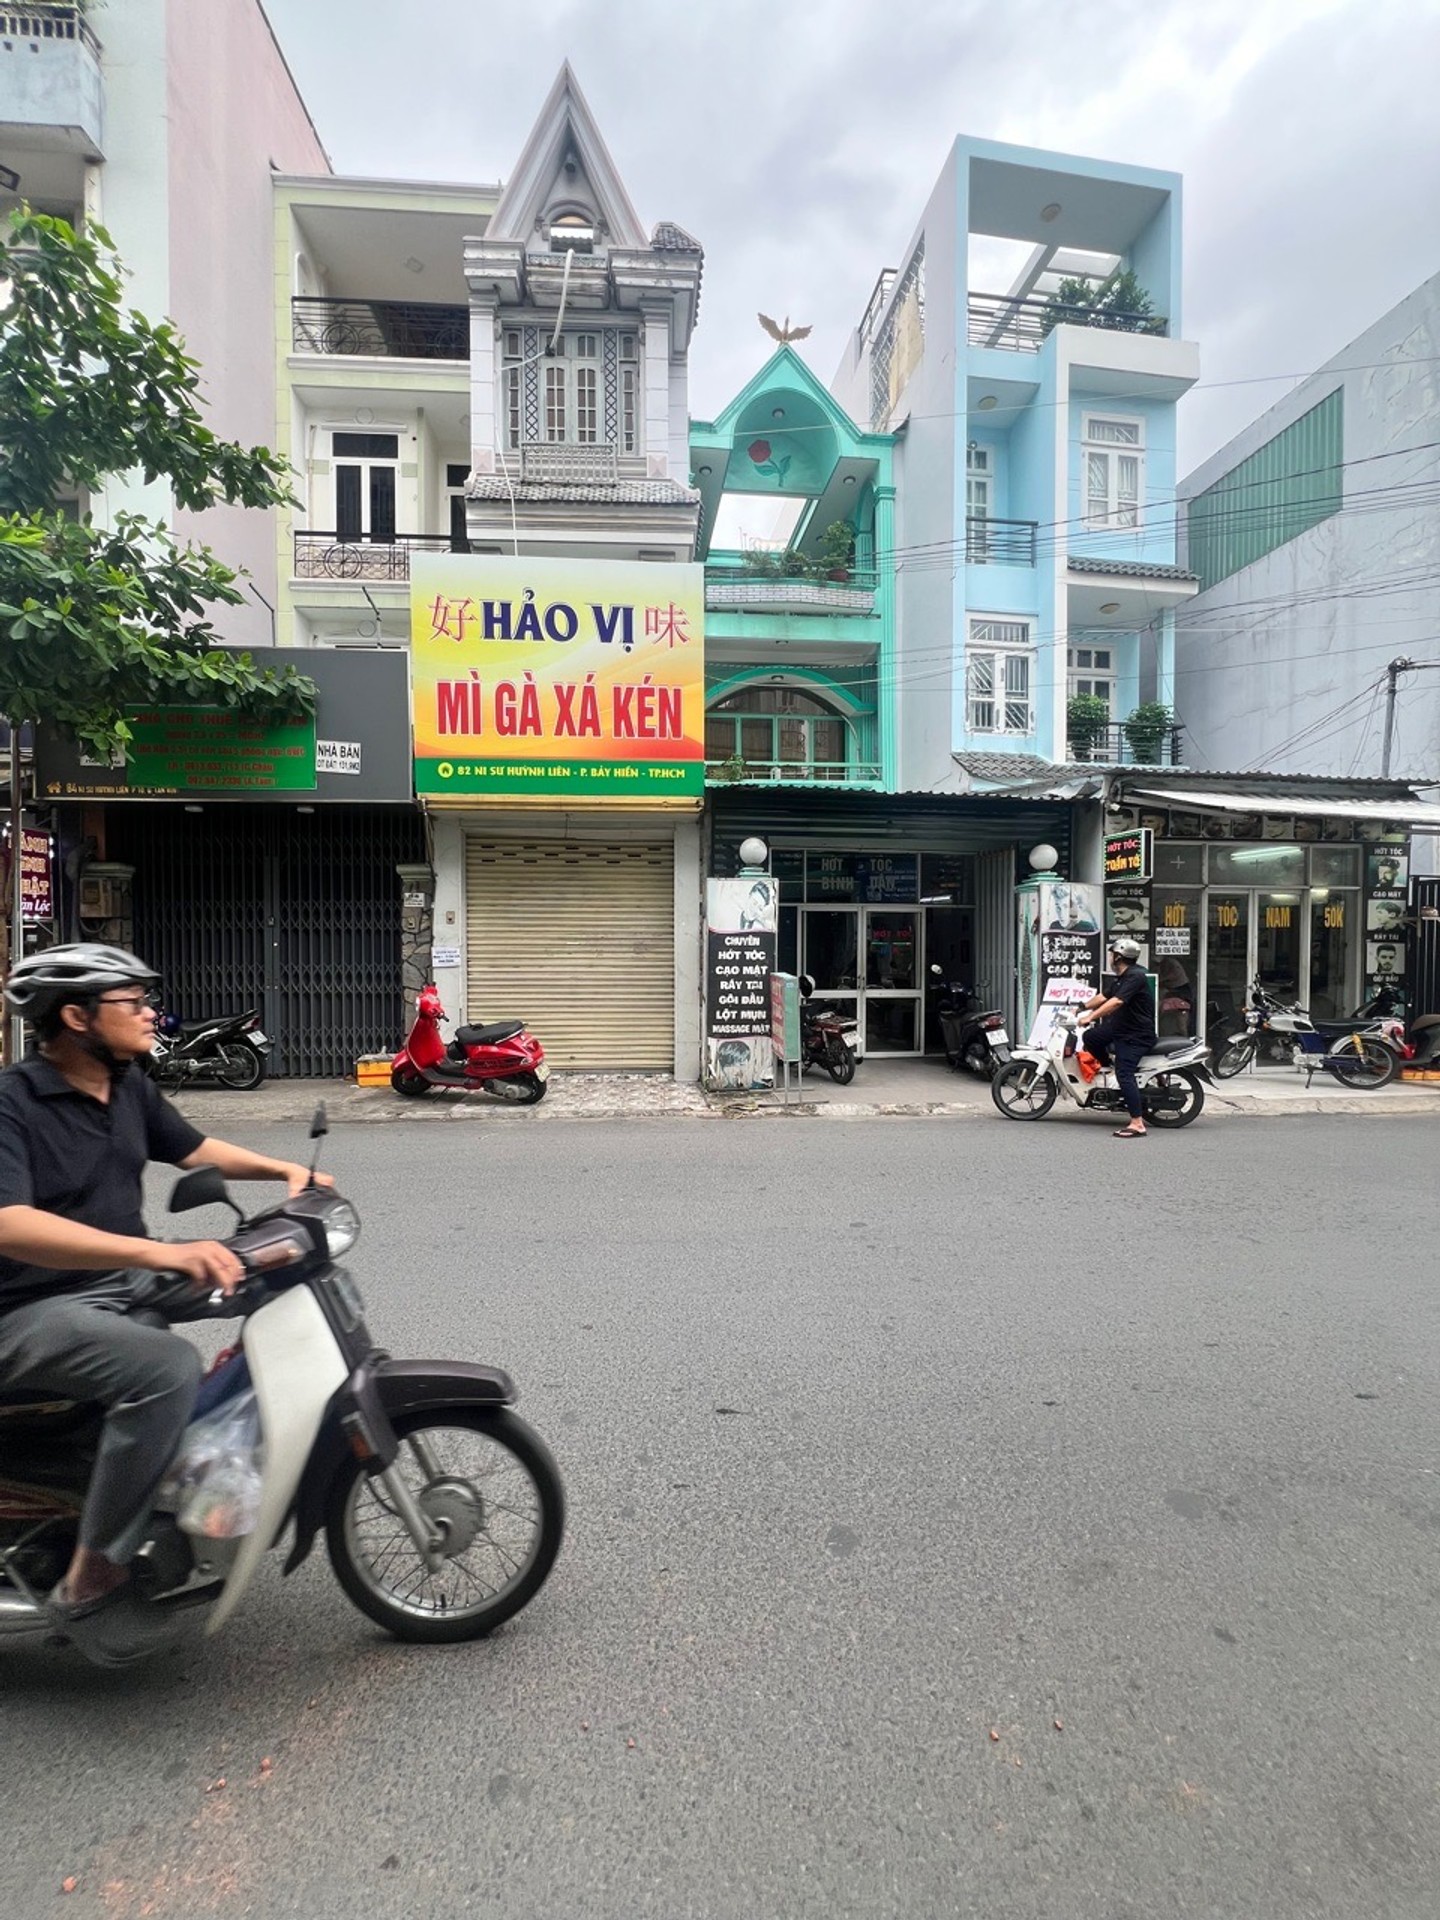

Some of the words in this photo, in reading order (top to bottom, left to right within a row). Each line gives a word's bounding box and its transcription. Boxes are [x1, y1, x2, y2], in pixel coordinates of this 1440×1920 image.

[428, 593, 476, 642] 好
[482, 587, 579, 642] HẢO
[588, 603, 635, 653] VỊ
[644, 602, 690, 648] 味
[436, 668, 482, 735] MÌ
[495, 671, 543, 736] GÀ
[553, 672, 601, 738] XÁ
[613, 674, 682, 739] KÉN
[457, 766, 472, 776] 82
[474, 766, 487, 776] NI
[490, 766, 505, 776] SƯ
[548, 765, 571, 777] LIÊN
[580, 768, 588, 777] P.
[648, 768, 686, 779] TP.HCM
[34, 899, 50, 914] Lộc
[1165, 901, 1185, 927] HỚT
[1217, 900, 1238, 927] TÓC
[1265, 907, 1290, 928] NAM
[1324, 907, 1344, 928] 50K
[724, 935, 760, 947] CHUYÊN
[715, 966, 740, 977] CẠO
[1047, 965, 1070, 976] CẠO
[741, 1011, 766, 1021] MỤN
[712, 1025, 750, 1034] MASSAGE
